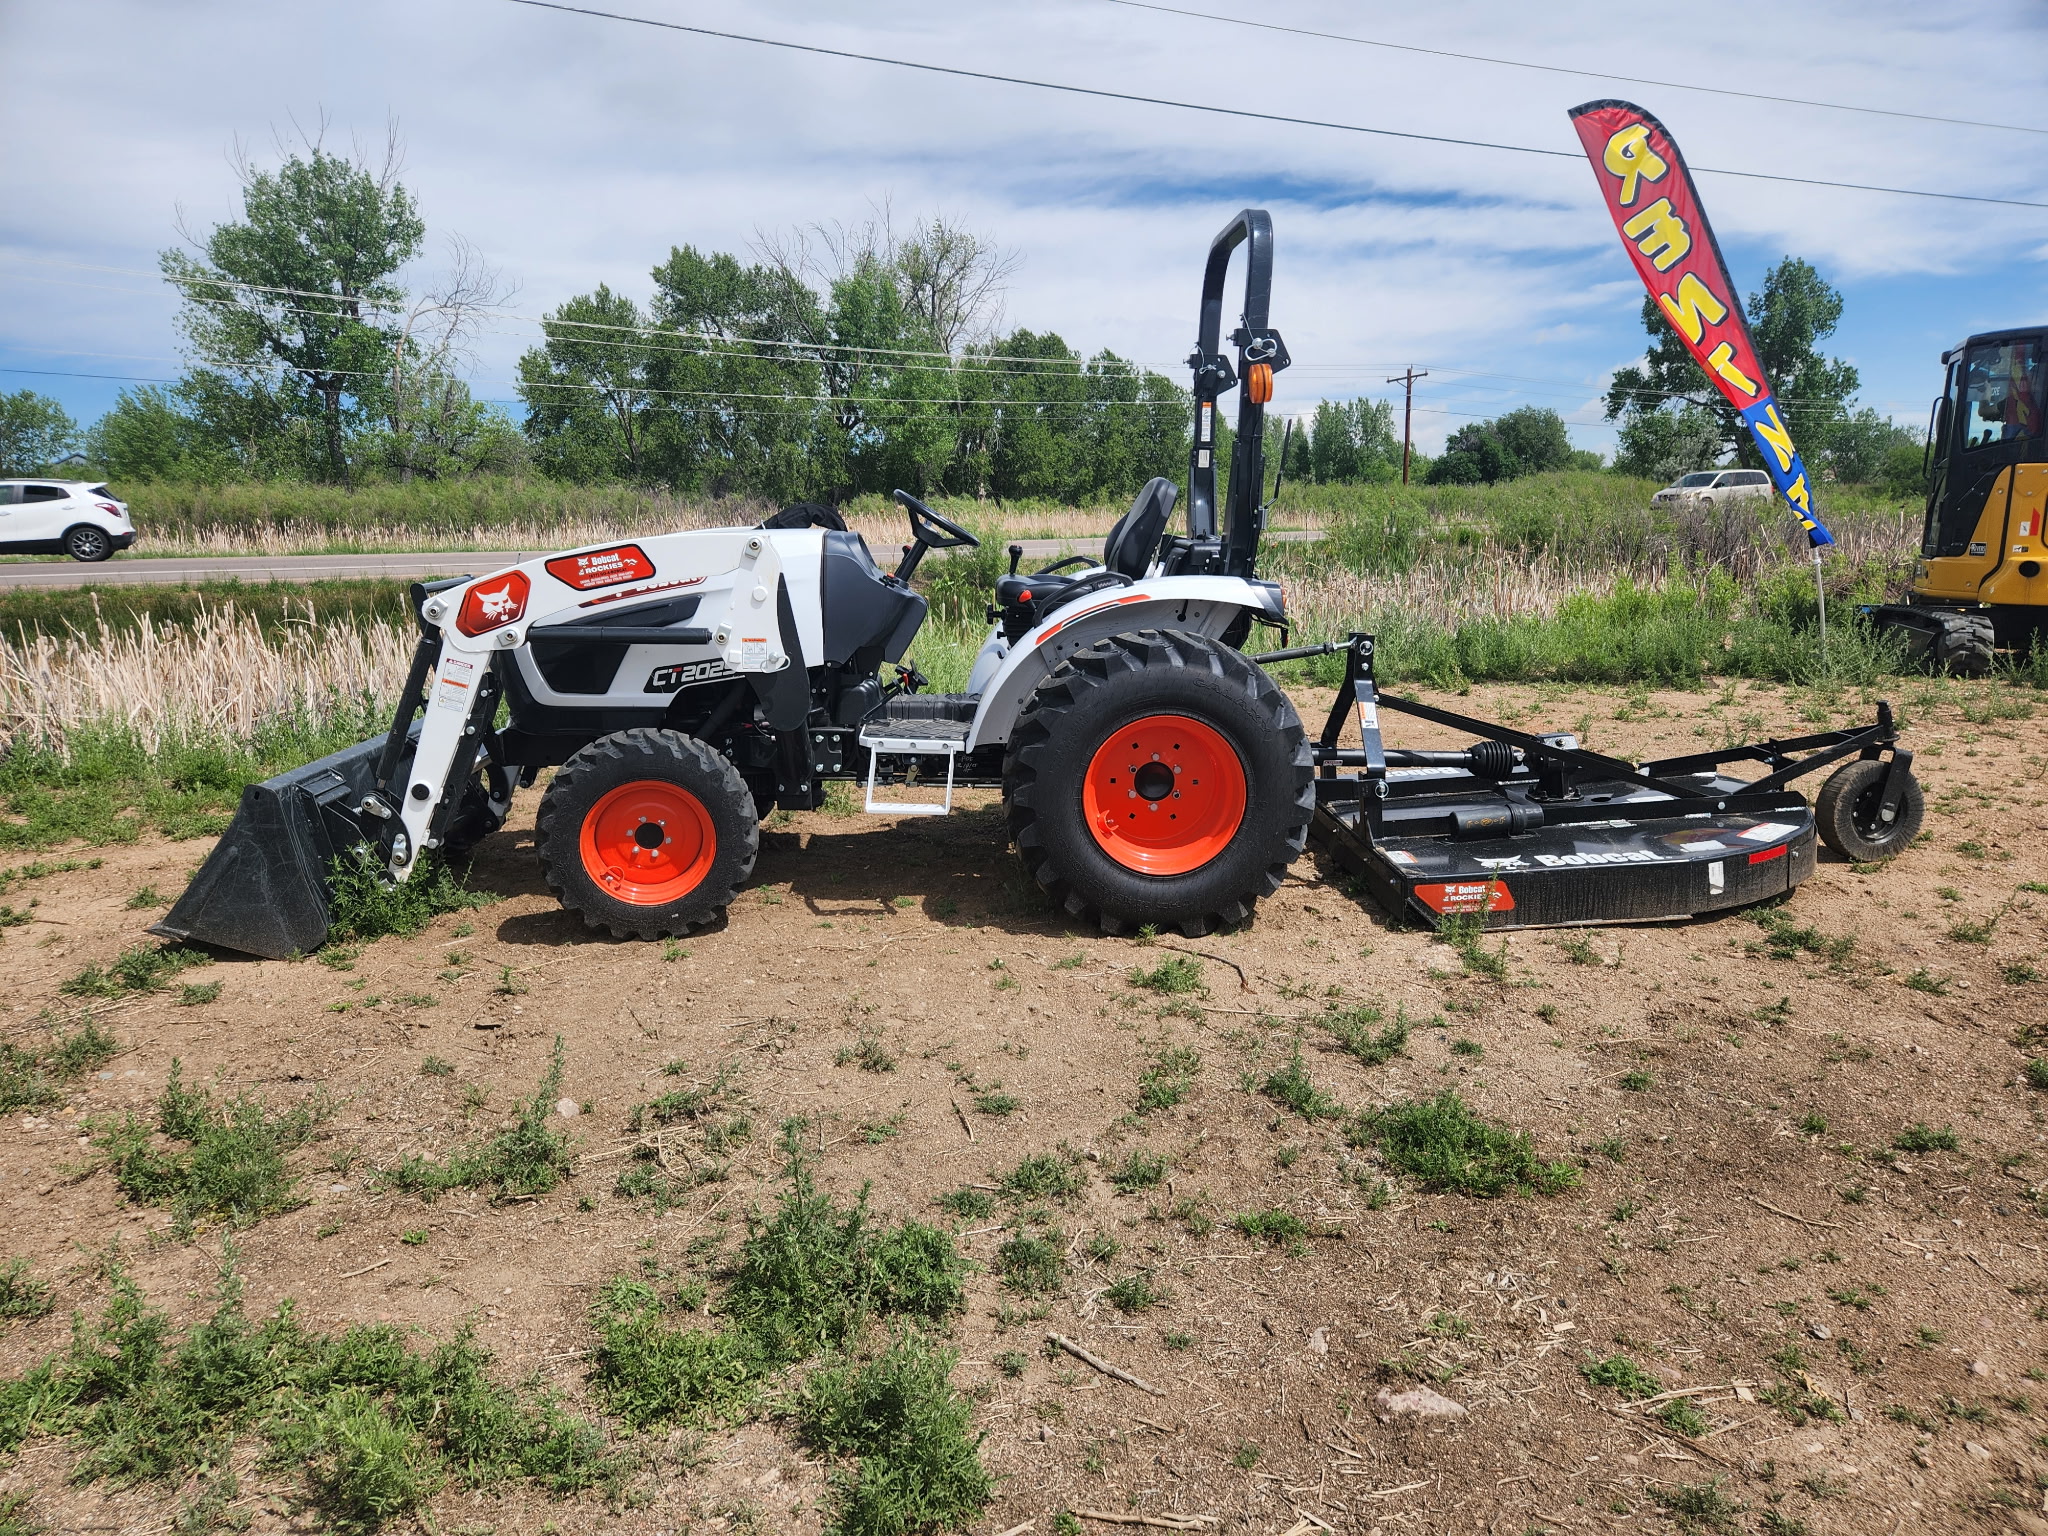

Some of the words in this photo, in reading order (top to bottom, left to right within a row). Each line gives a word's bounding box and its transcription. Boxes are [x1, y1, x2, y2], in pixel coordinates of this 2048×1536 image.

[591, 553, 620, 566] Bobcat
[585, 562, 624, 575] ROCKIES
[1534, 850, 1664, 867] Bobcat
[1458, 885, 1486, 894] Bobcat
